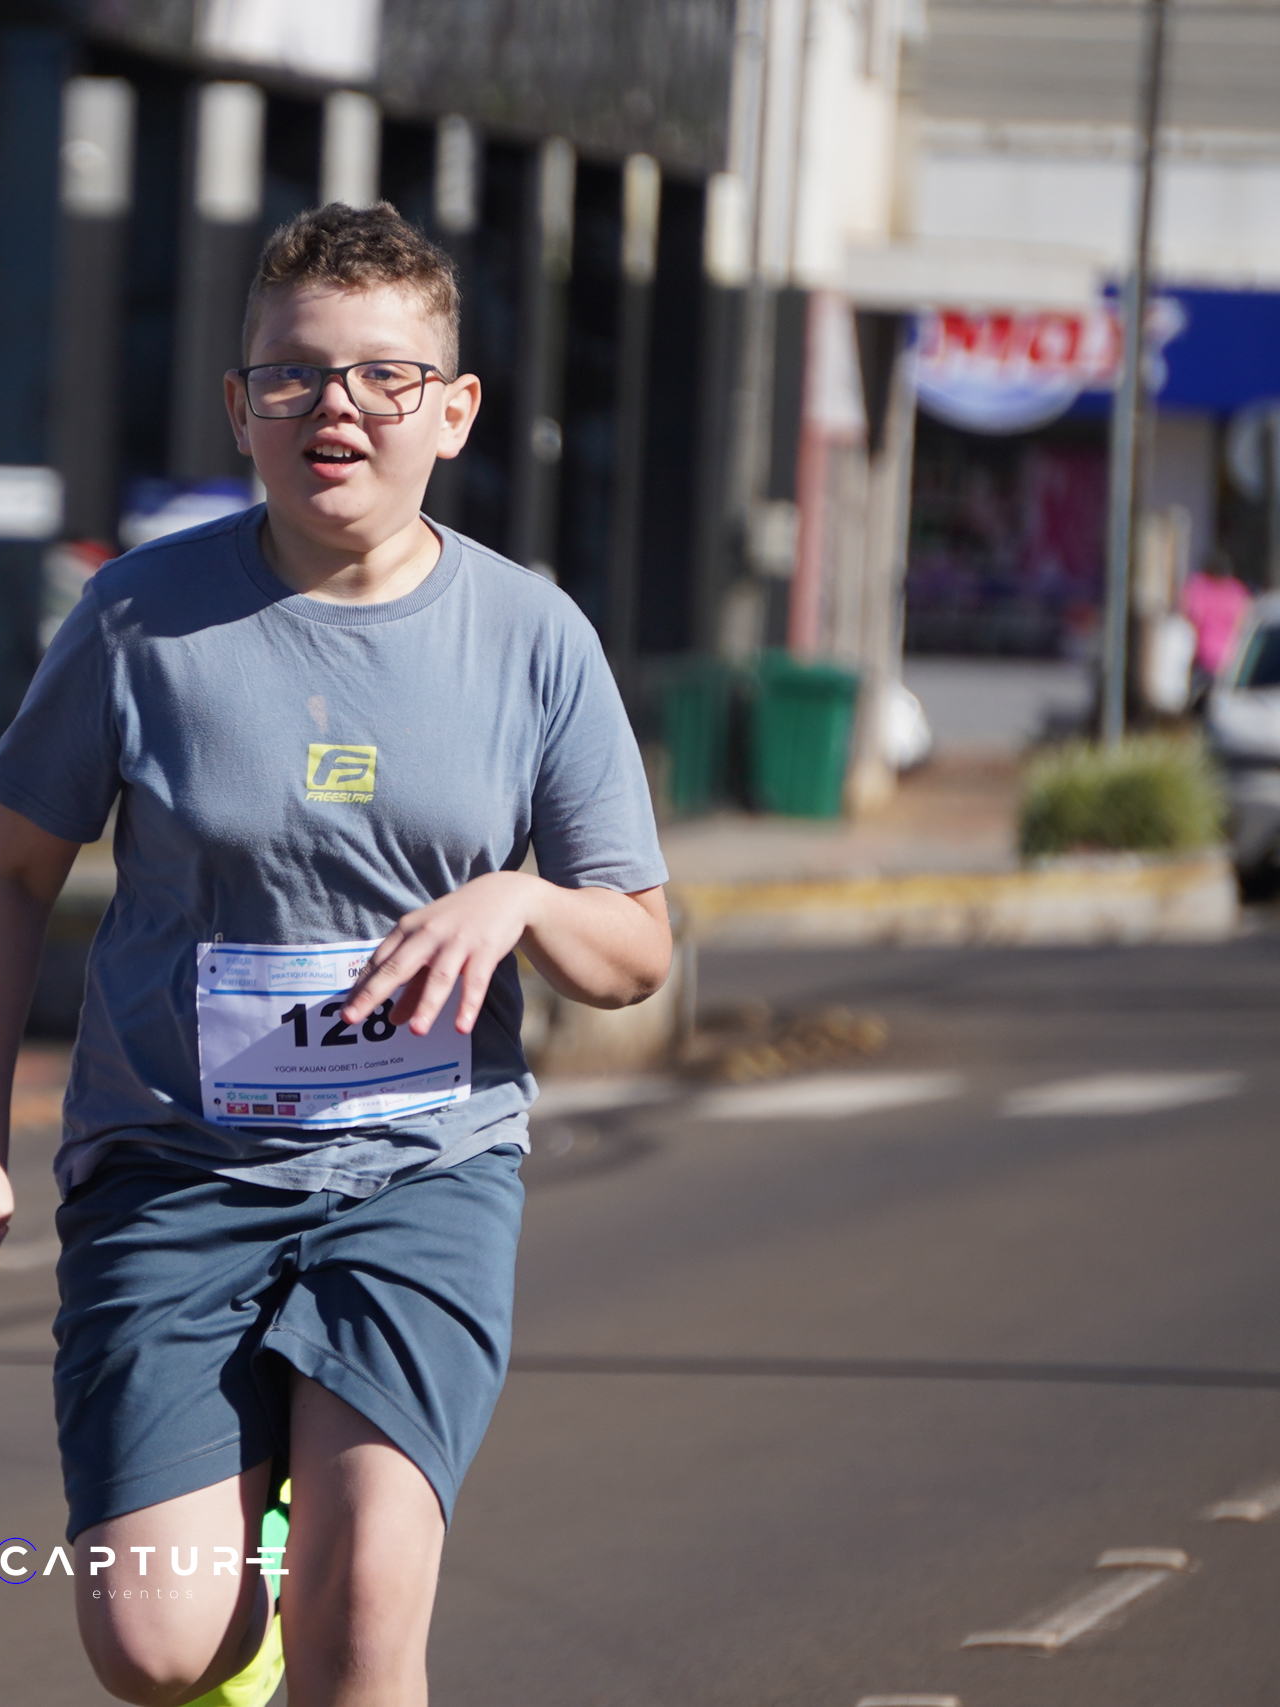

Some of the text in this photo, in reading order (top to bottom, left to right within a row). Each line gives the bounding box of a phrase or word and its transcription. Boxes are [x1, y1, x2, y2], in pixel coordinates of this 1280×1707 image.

[306, 791, 374, 804] FREESURF
[272, 971, 333, 980] PRATIQUE AJUDA
[281, 998, 397, 1048] 128
[274, 1065, 297, 1073] YGOR
[299, 1065, 326, 1073] KAUAN
[328, 1063, 358, 1072] GOBETI
[364, 1059, 388, 1069] Corrida
[238, 1092, 268, 1101] Sicredi
